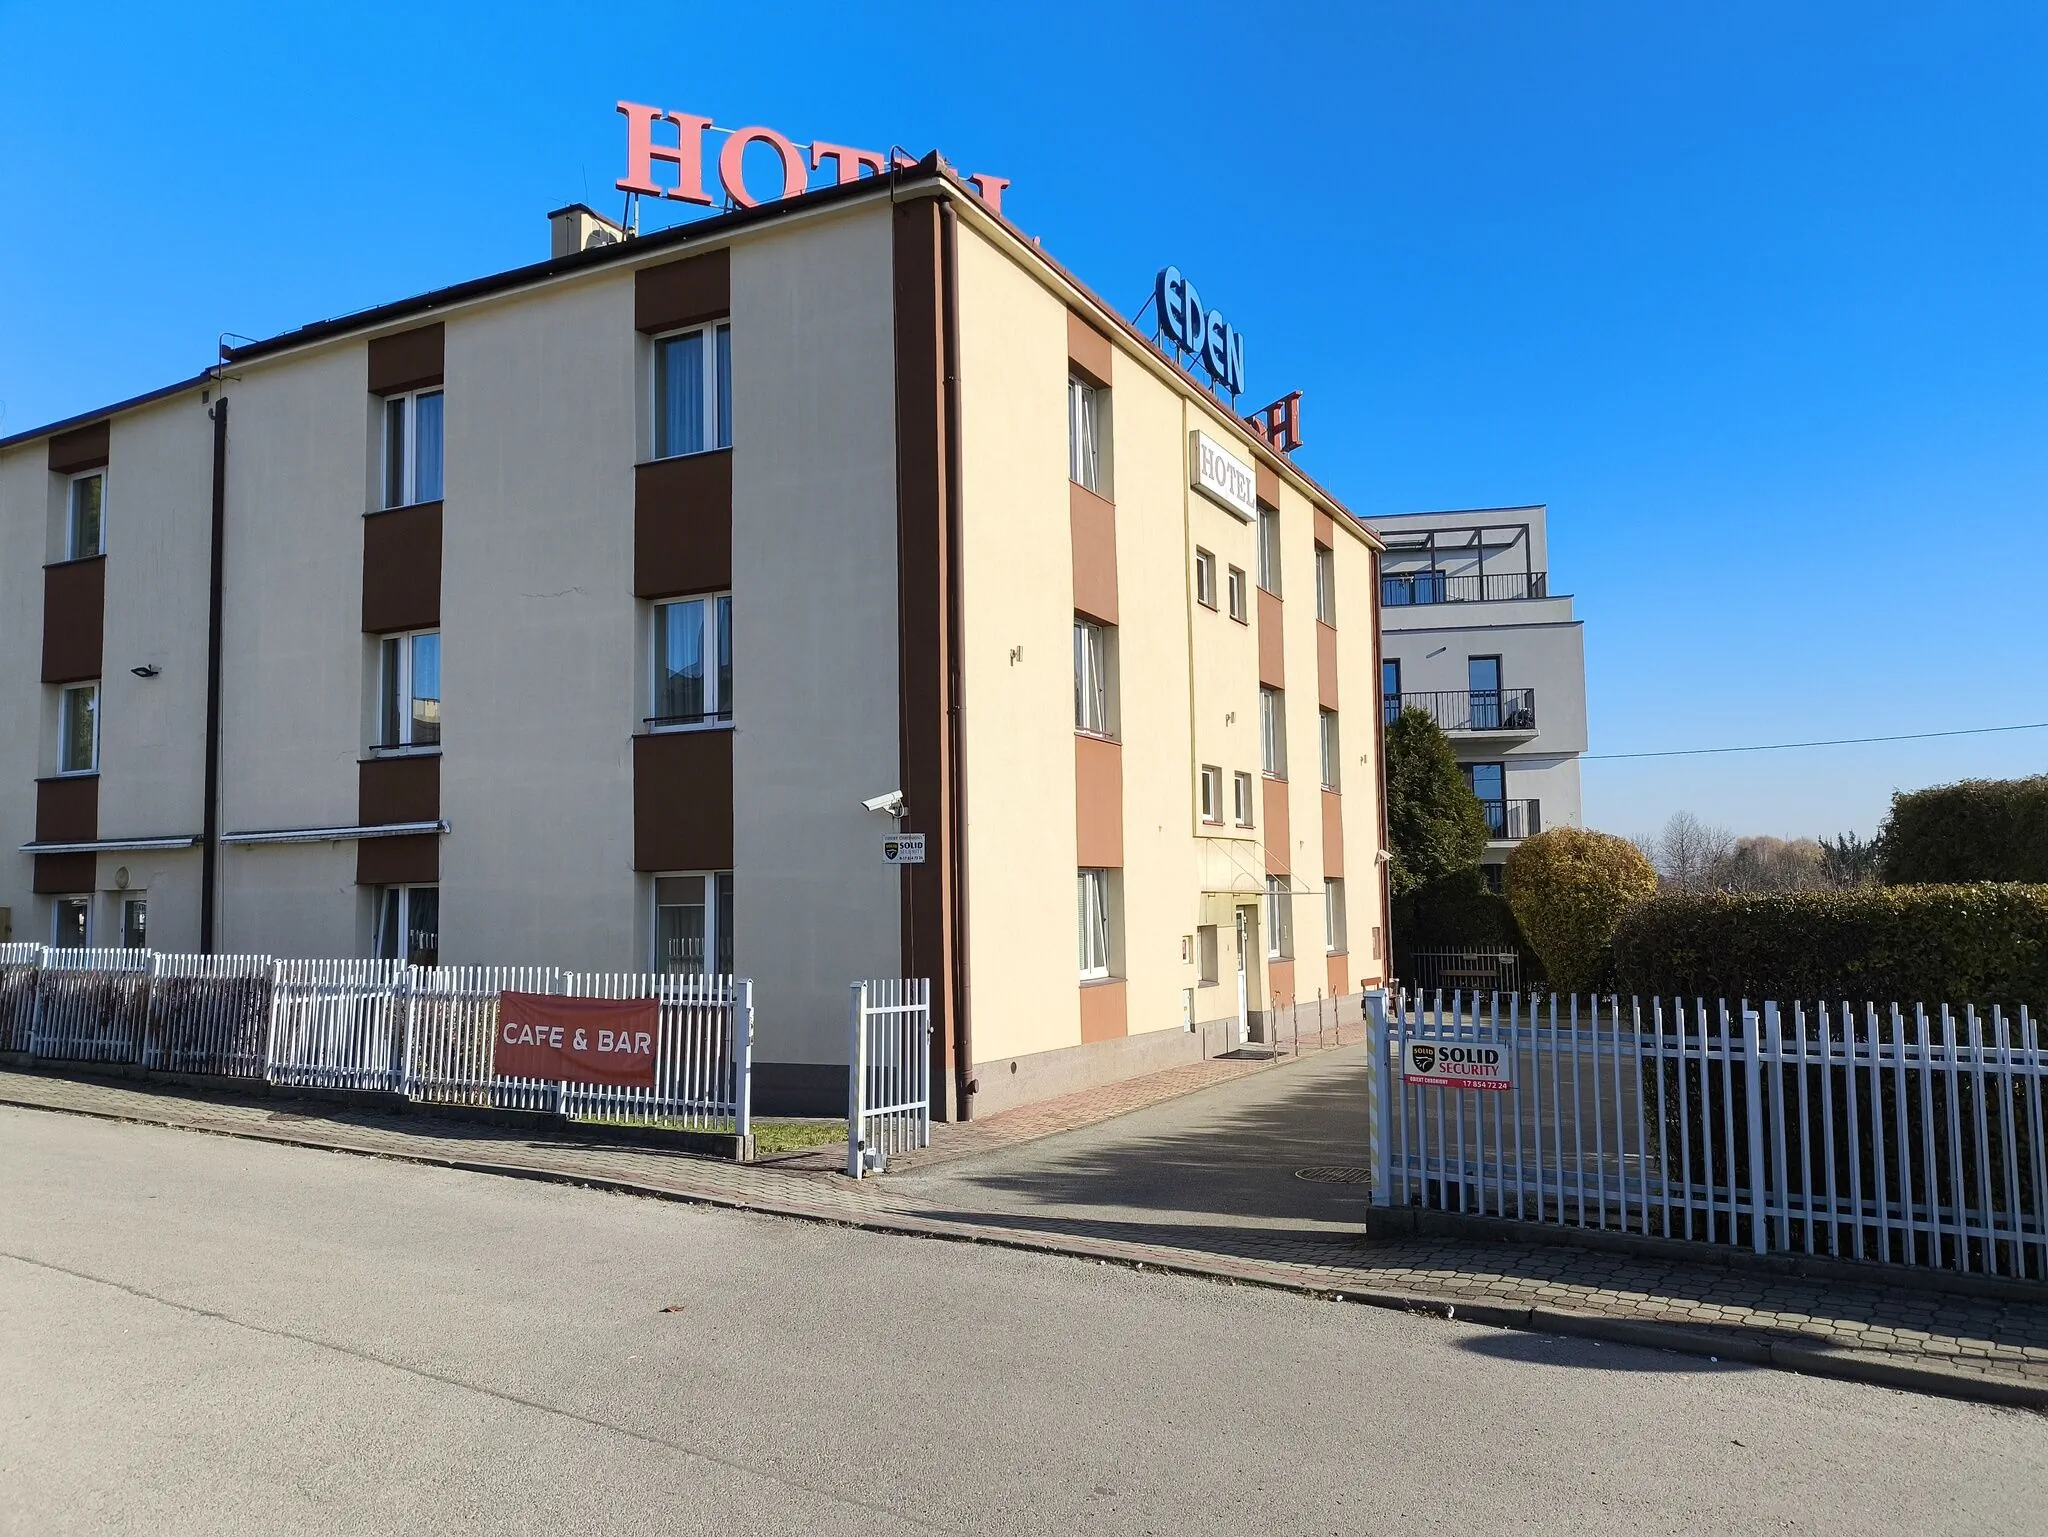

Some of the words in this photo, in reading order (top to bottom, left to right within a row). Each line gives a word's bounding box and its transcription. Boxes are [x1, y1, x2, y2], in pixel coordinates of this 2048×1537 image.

[615, 100, 1011, 215] HOT
[1156, 265, 1244, 394] EDEN
[1201, 443, 1255, 508] HOTEL
[900, 841, 923, 849] SOLID
[503, 1022, 565, 1049] CAFE
[573, 1028, 588, 1051] &
[597, 1030, 651, 1055] BAR
[1413, 1047, 1434, 1055] SOLID
[1438, 1047, 1499, 1065] SOLID
[1439, 1063, 1499, 1076] SECURITY
